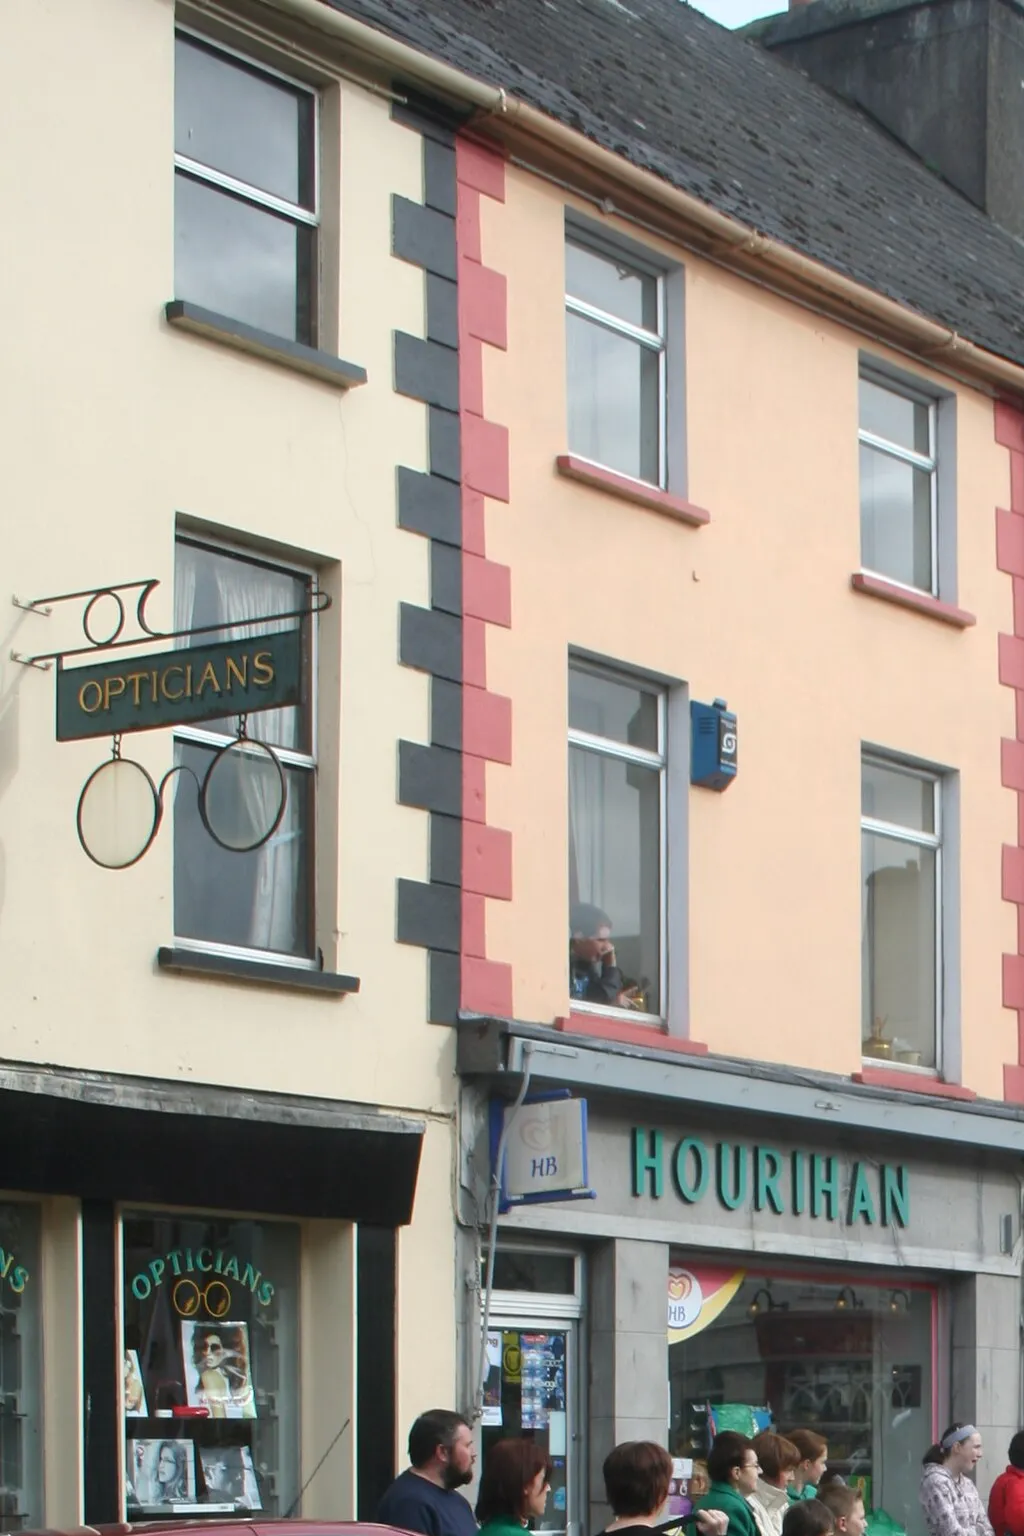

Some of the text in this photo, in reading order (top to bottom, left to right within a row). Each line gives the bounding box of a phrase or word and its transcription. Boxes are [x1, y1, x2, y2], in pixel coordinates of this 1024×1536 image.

[79, 651, 274, 713] OPTICIANS
[531, 1155, 558, 1178] HB
[630, 1126, 910, 1229] HOURIHAN
[131, 1247, 275, 1306] OPTICIANS
[668, 1305, 686, 1322] HB
